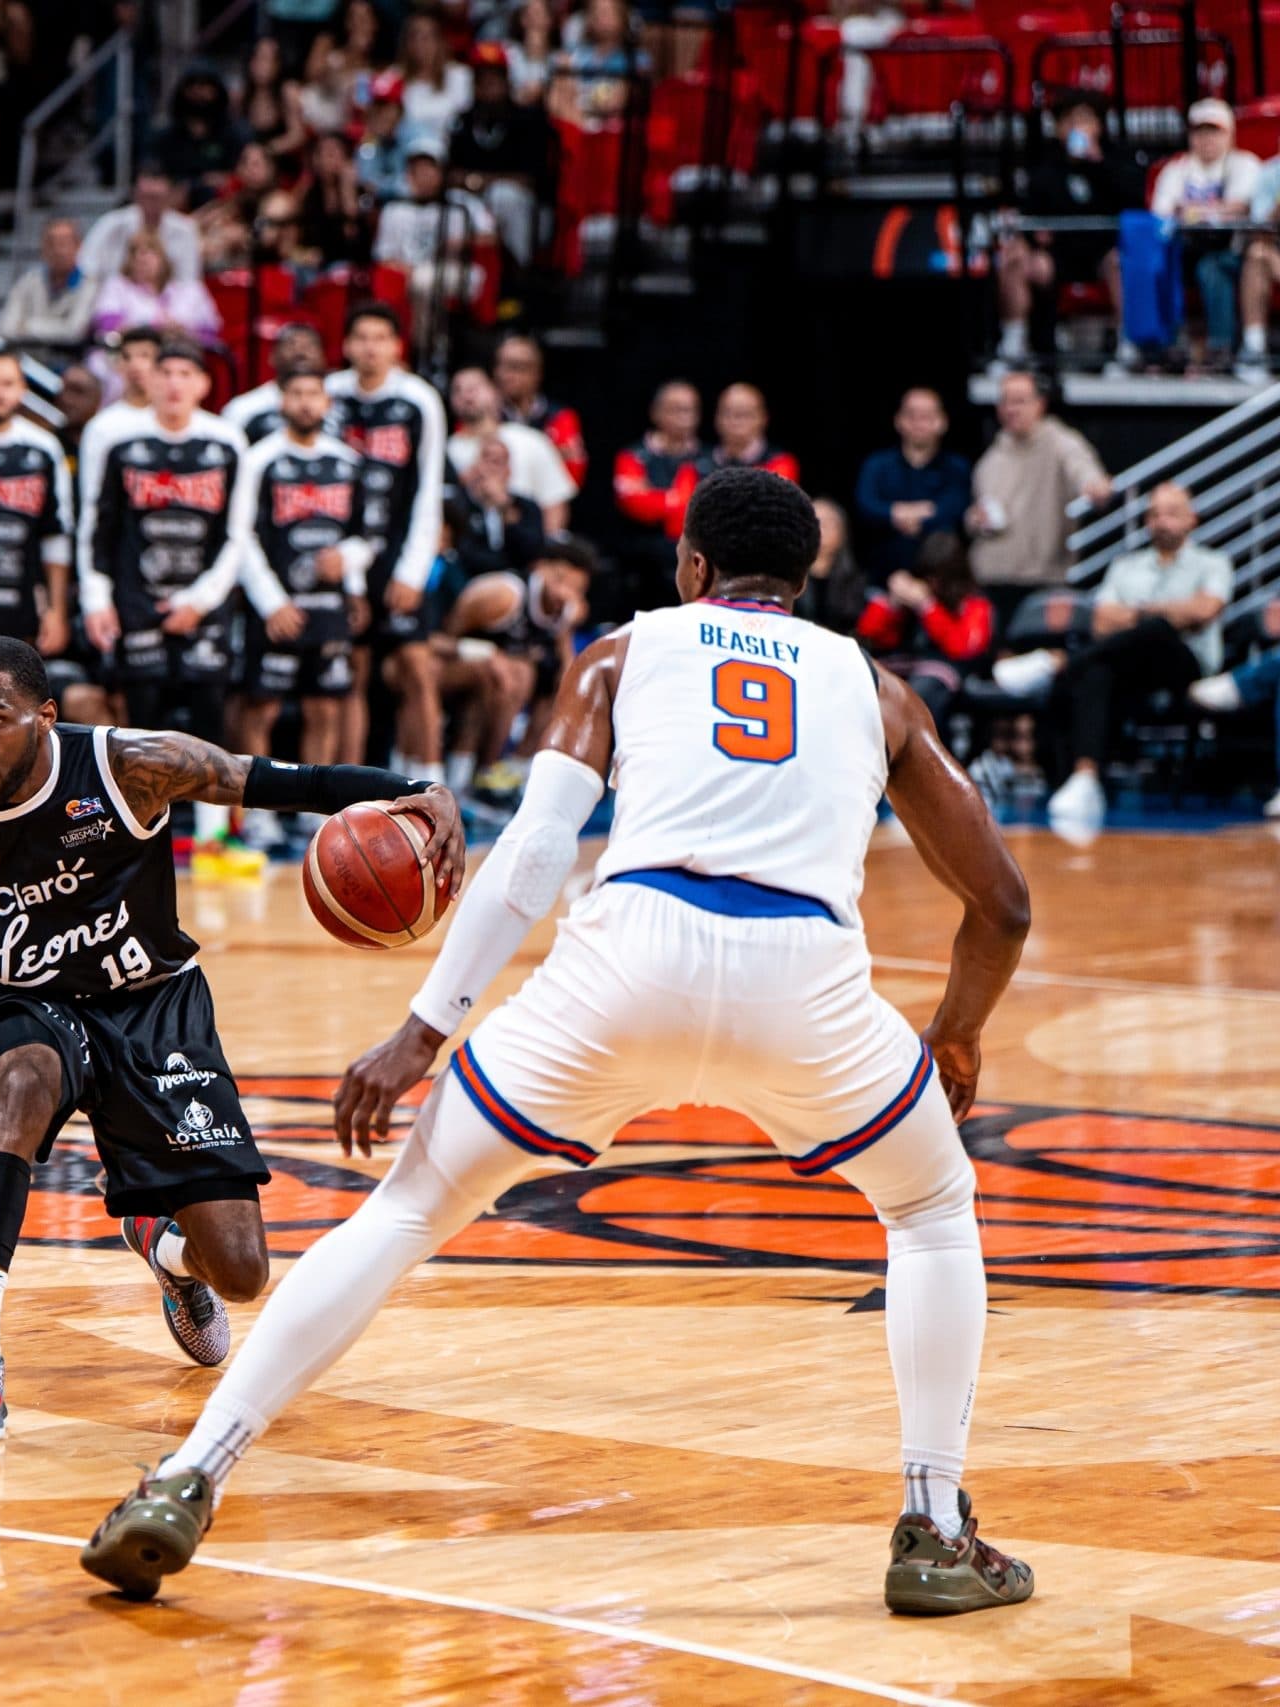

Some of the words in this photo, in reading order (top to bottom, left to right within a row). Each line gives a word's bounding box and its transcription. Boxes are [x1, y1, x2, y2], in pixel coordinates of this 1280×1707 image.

[700, 623, 800, 664] BEASLEY
[711, 658, 797, 766] 9
[60, 826, 100, 844] TURISMO
[101, 936, 152, 990] 19
[165, 1123, 242, 1145] LOTERÍA
[192, 1140, 219, 1150] PUERTO
